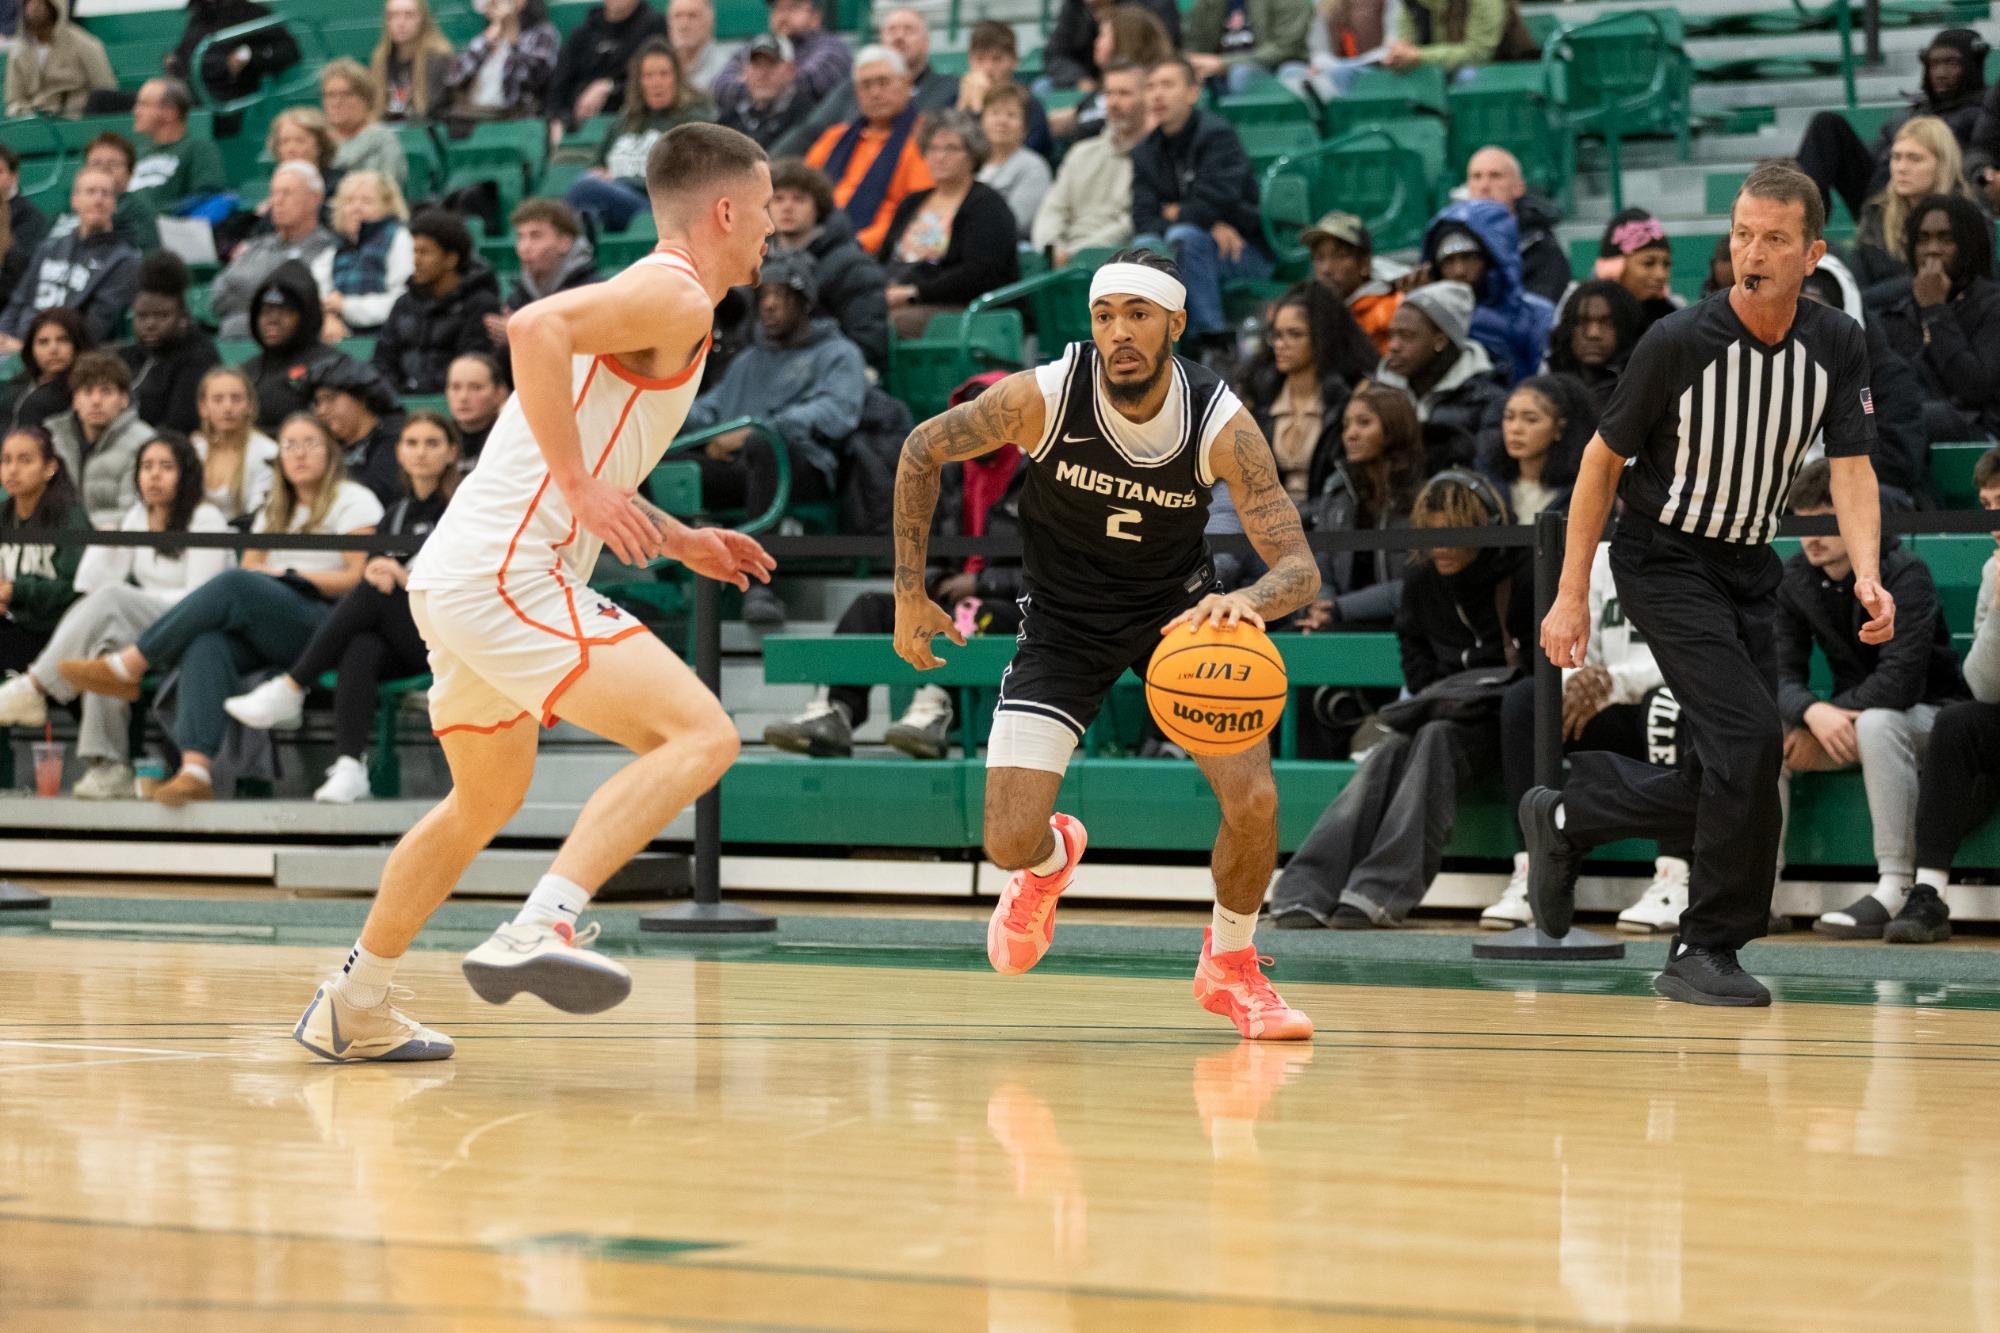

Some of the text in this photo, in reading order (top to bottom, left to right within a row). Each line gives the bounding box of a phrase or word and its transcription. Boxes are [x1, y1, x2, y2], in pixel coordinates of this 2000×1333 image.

[1055, 460, 1197, 508] MUSTANGS
[1106, 504, 1143, 542] 2
[1178, 662, 1252, 682] EVO NXT
[1173, 701, 1264, 734] Wilson
